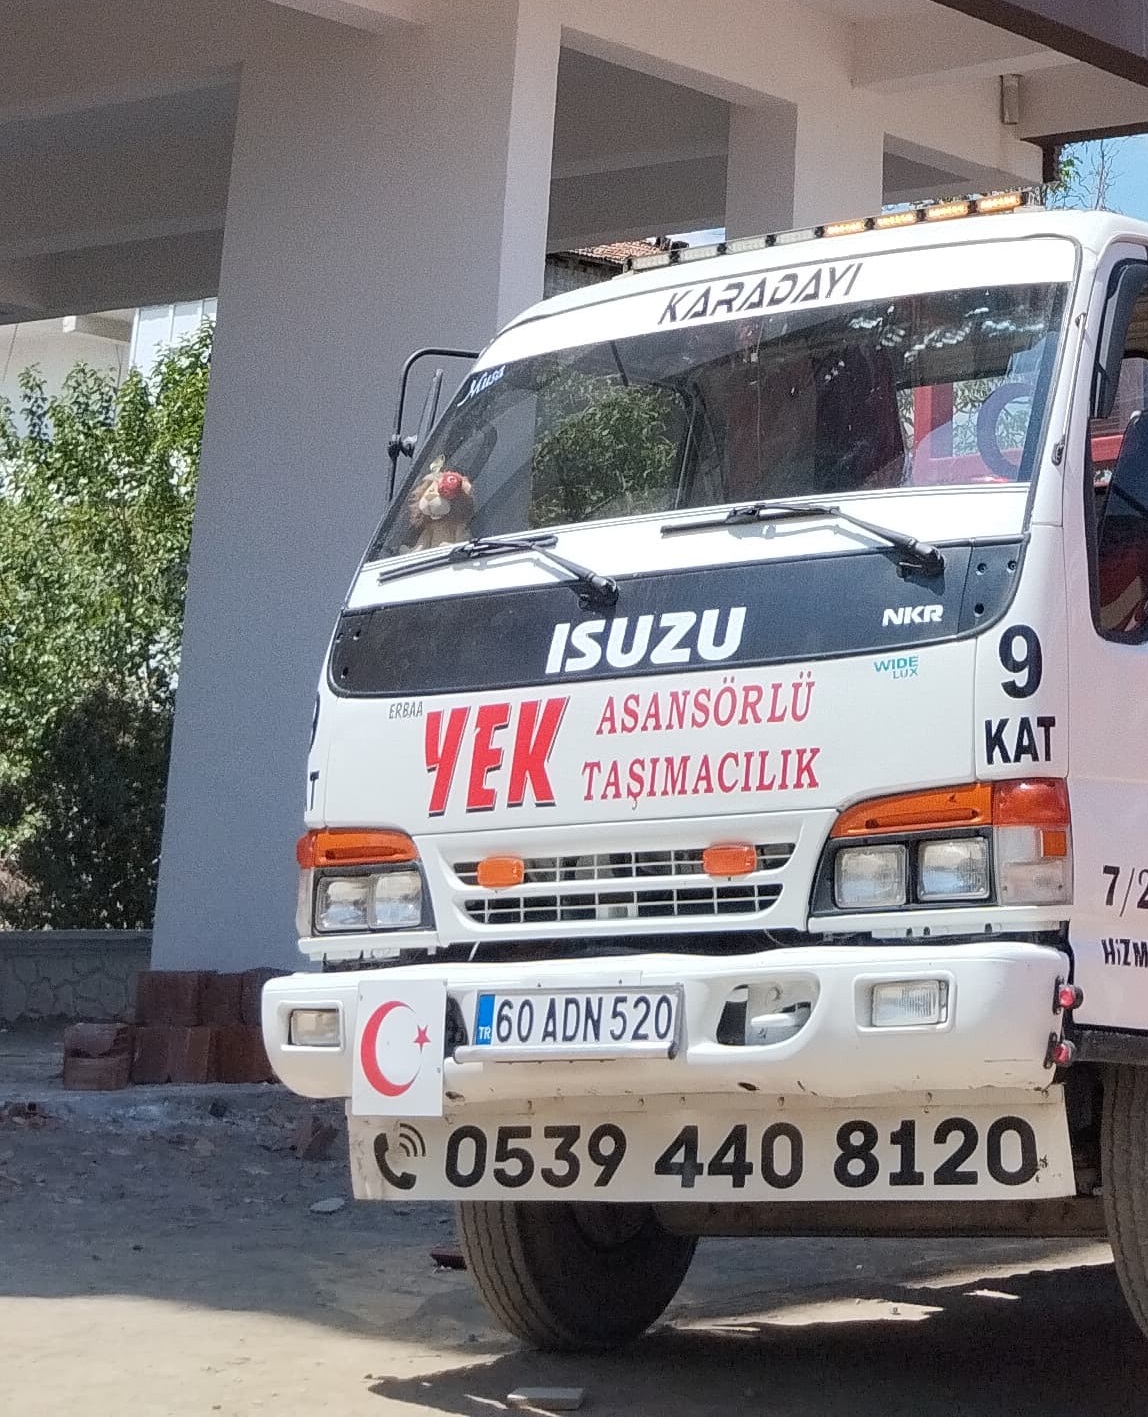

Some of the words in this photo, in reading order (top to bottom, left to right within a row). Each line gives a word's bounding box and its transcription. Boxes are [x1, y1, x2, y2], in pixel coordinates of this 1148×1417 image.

[657, 262, 863, 325] KARADAYI
[545, 606, 747, 674] ISUZU
[882, 604, 944, 627] NKR
[873, 656, 919, 673] WIDE
[892, 667, 919, 679] LUX
[998, 624, 1043, 699] 9
[388, 701, 423, 720] ERBAA
[595, 670, 816, 736] ASANSÖRLÜ
[425, 696, 570, 818] YEK
[984, 716, 1056, 765] KAT
[581, 747, 821, 810] TAŞIMACILIK
[478, 1026, 492, 1040] TR
[496, 999, 534, 1043] 60
[541, 997, 603, 1042] ADN
[610, 995, 673, 1041] 520
[445, 1124, 627, 1188] 0539
[655, 1122, 803, 1188] 440
[833, 1116, 1038, 1188] 8120
